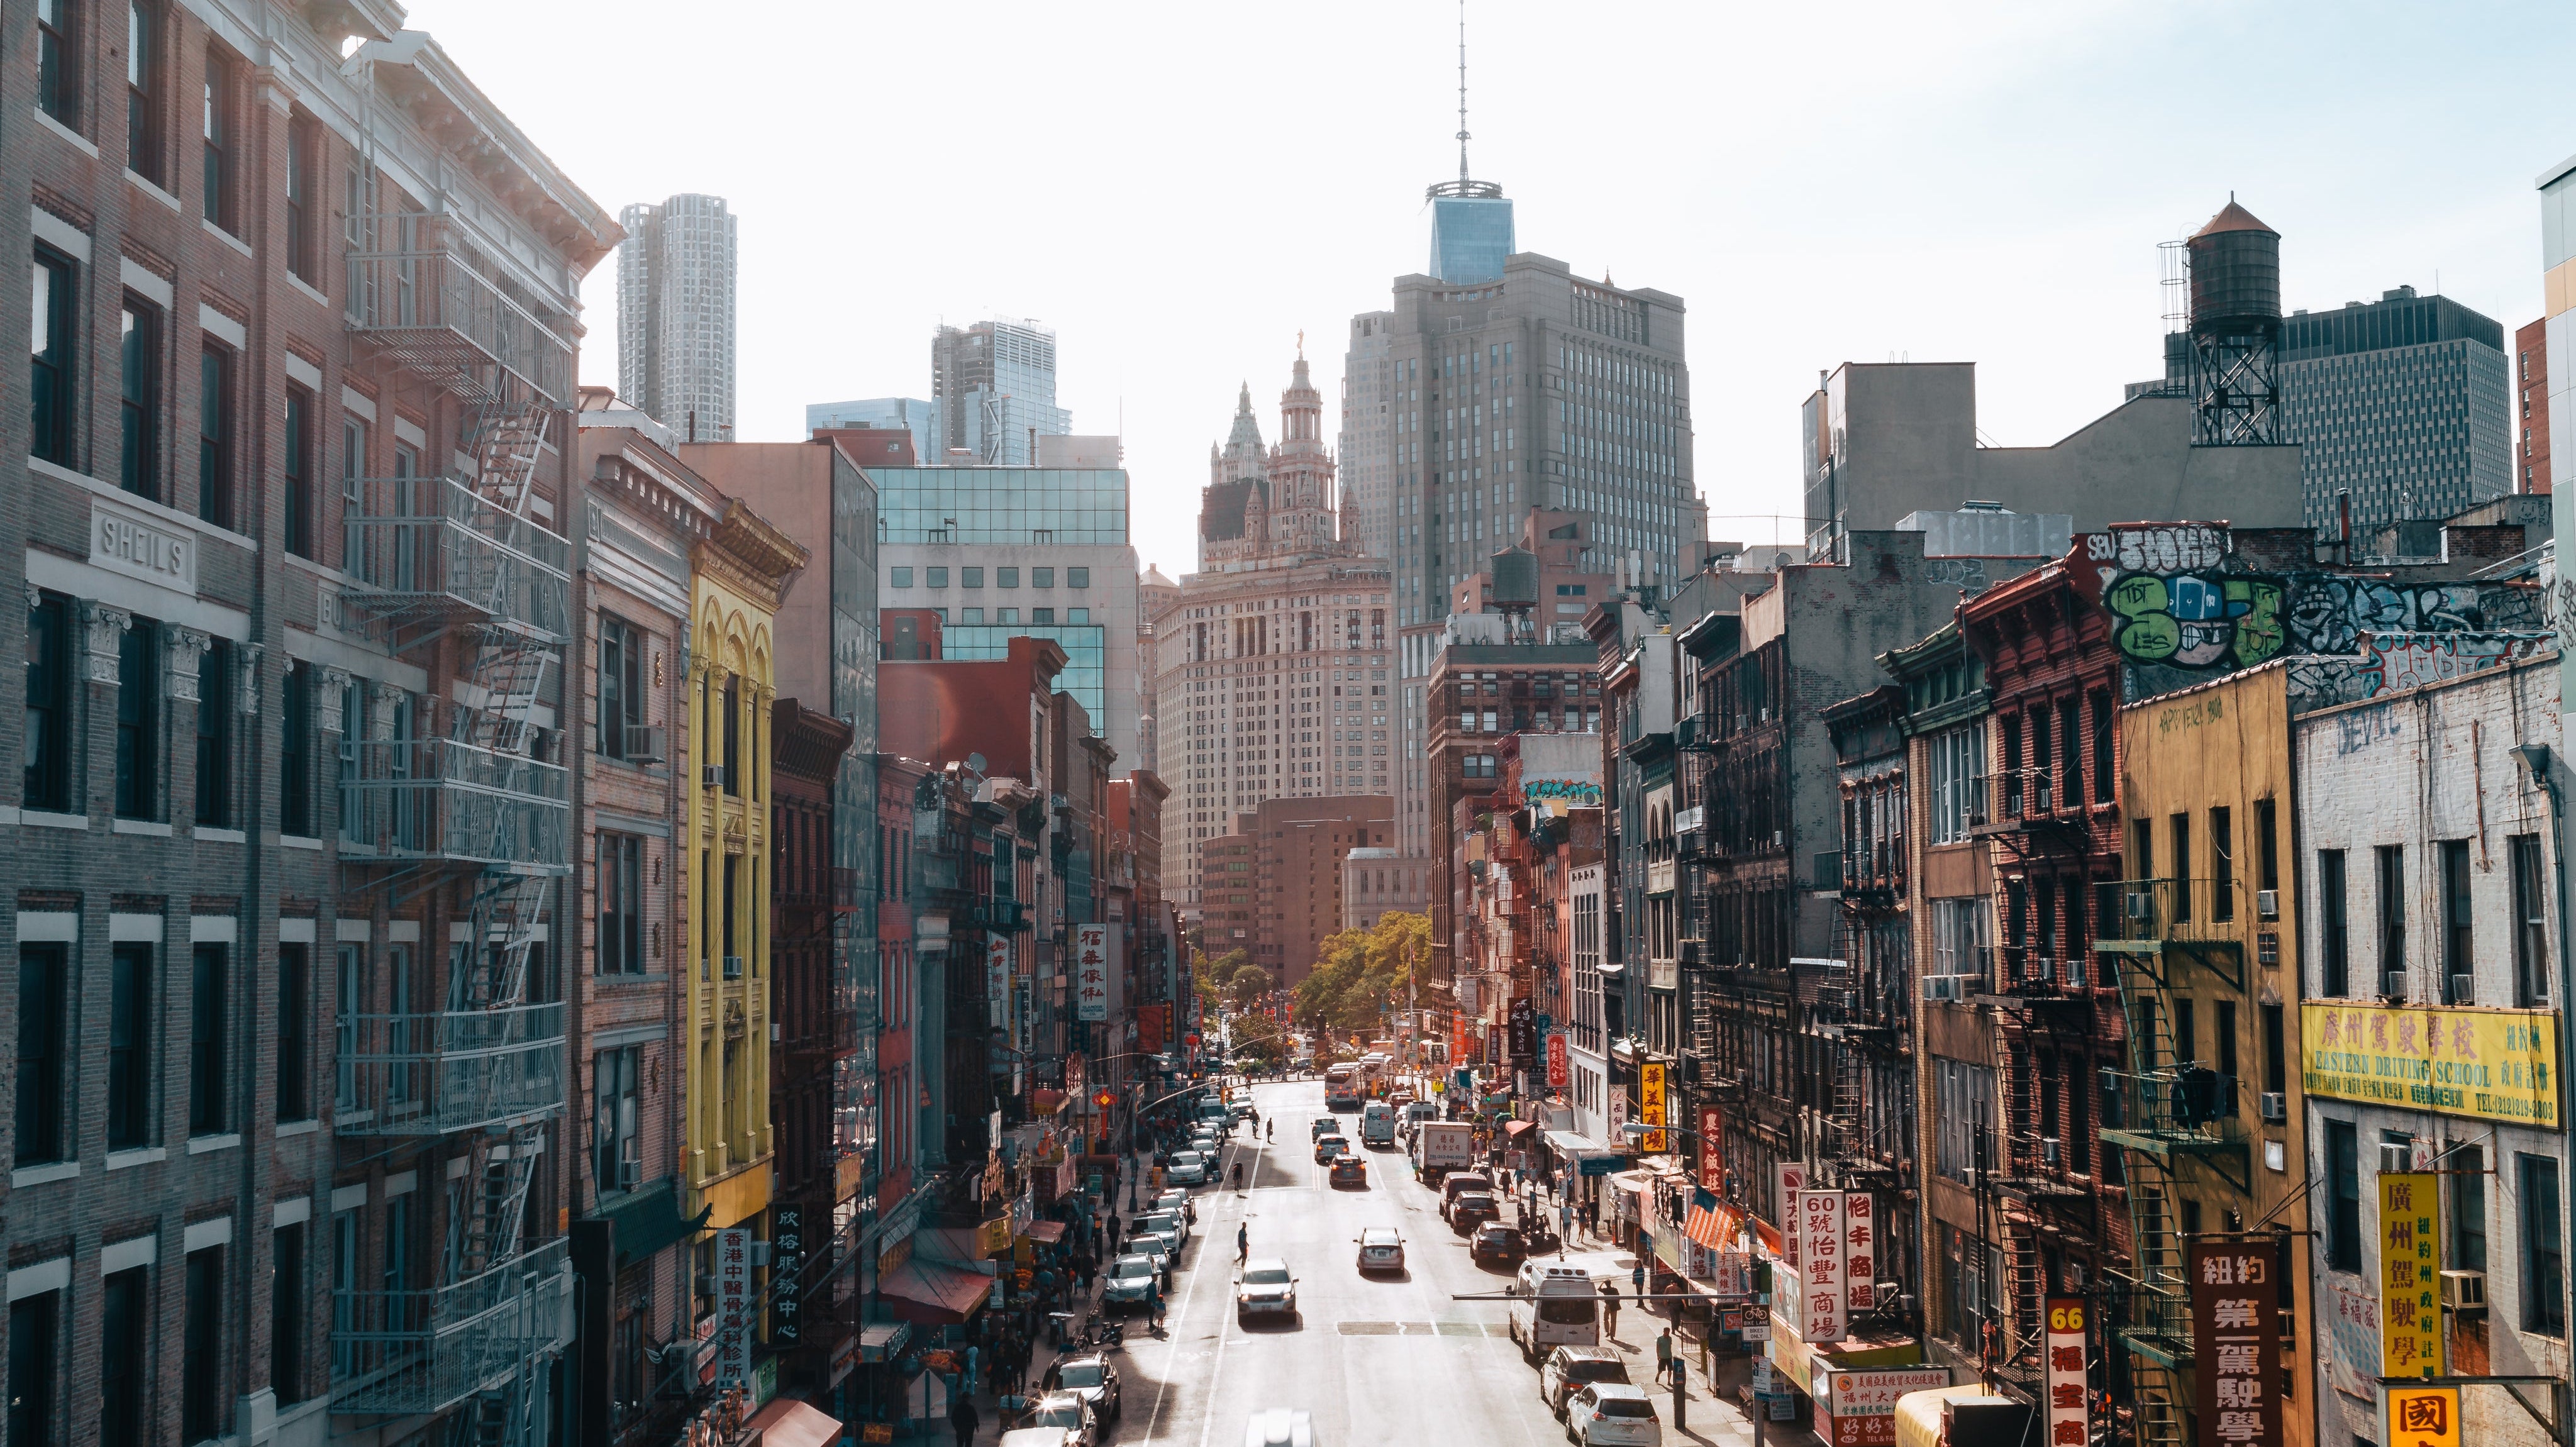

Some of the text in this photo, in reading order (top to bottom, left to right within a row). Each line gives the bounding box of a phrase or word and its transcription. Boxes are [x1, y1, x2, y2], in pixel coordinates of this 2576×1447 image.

[101, 518, 182, 575] SHEILS
[2321, 1009, 2478, 1060] 廣州駕駛學校
[2506, 1023, 2541, 1053] 紐約州
[2315, 1050, 2492, 1088] EASTERN DRIVING SCHOOL
[1367, 1112, 1390, 1121] FedEx
[1644, 1067, 1664, 1149] 華美商場
[1703, 1112, 1721, 1192] 農家飯莊
[1847, 1196, 1873, 1308] 怡丰商場
[2202, 1256, 2265, 1284] 紐約
[723, 1232, 744, 1378] 香港中醫骨傷科診所
[2387, 1182, 2418, 1377] 廣州駕駛學
[2050, 1307, 2084, 1330] 66
[2339, 1294, 2380, 1329] 華福旅
[2214, 1298, 2265, 1447] 第一駕駛學
[1841, 1404, 1896, 1416] 管樂團民間十
